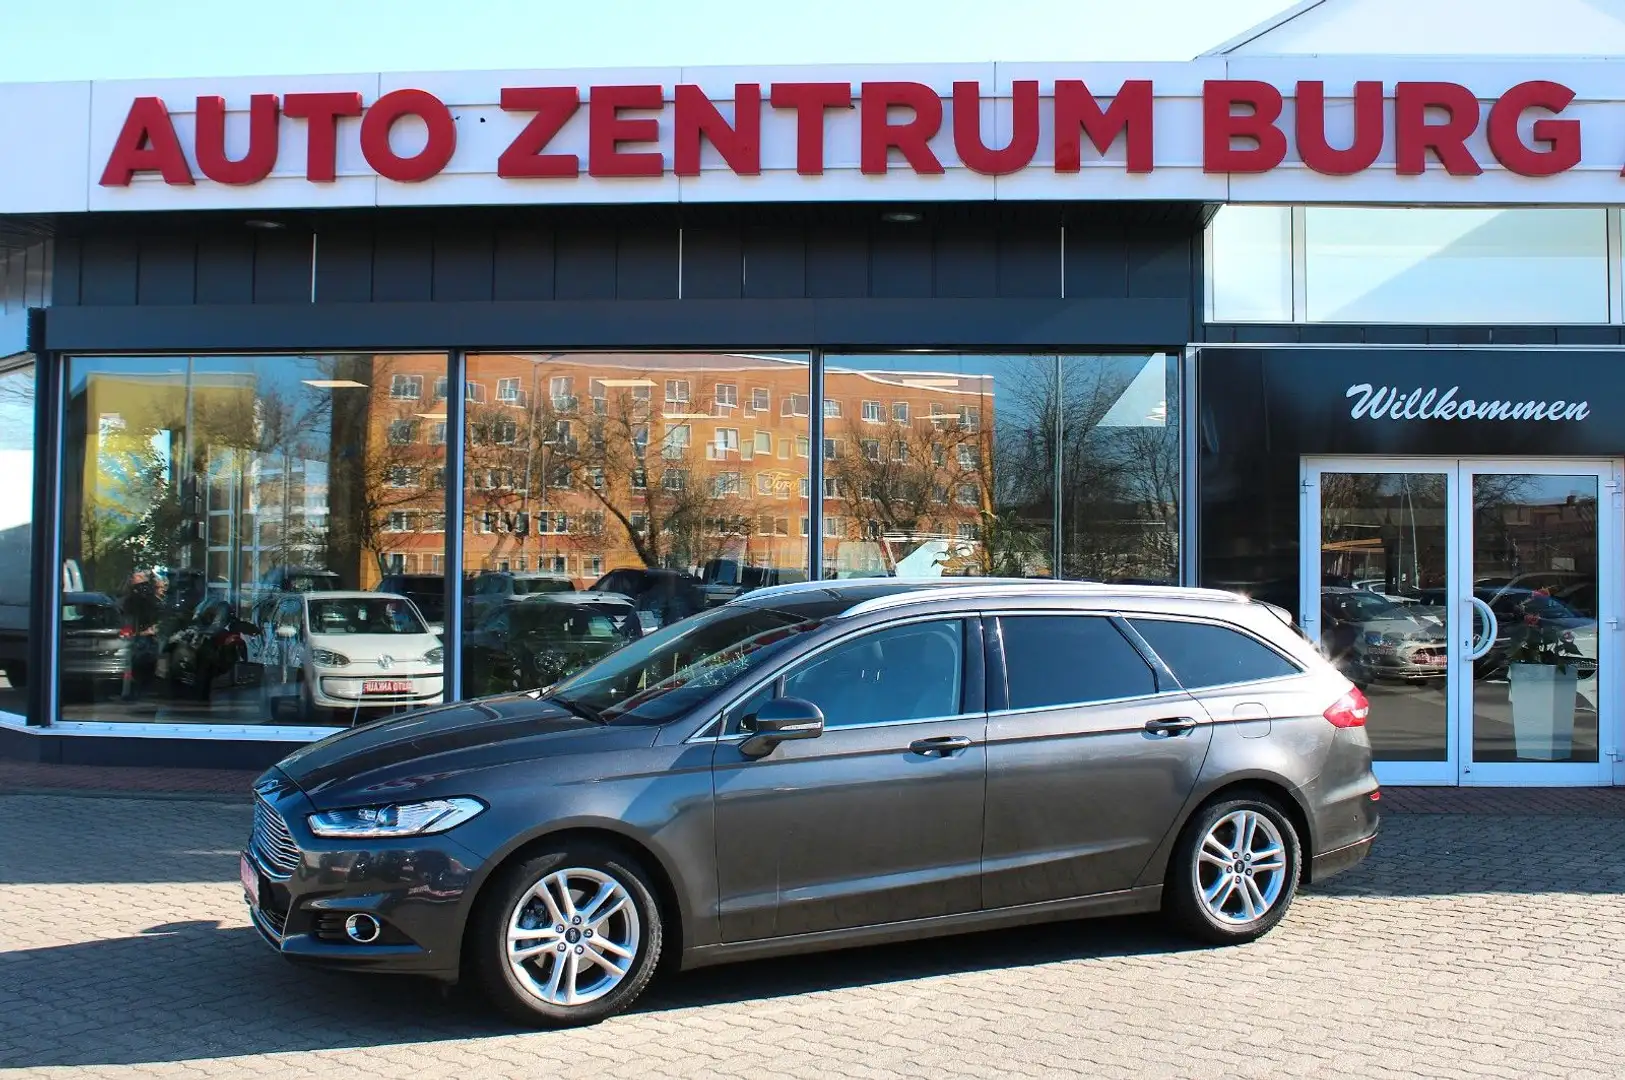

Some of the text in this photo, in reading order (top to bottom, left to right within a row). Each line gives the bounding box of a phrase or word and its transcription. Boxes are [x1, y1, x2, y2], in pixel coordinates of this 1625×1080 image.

[101, 81, 1581, 187] AUTO ZENTRUM BURG
[1346, 383, 1590, 421] Willkommen
